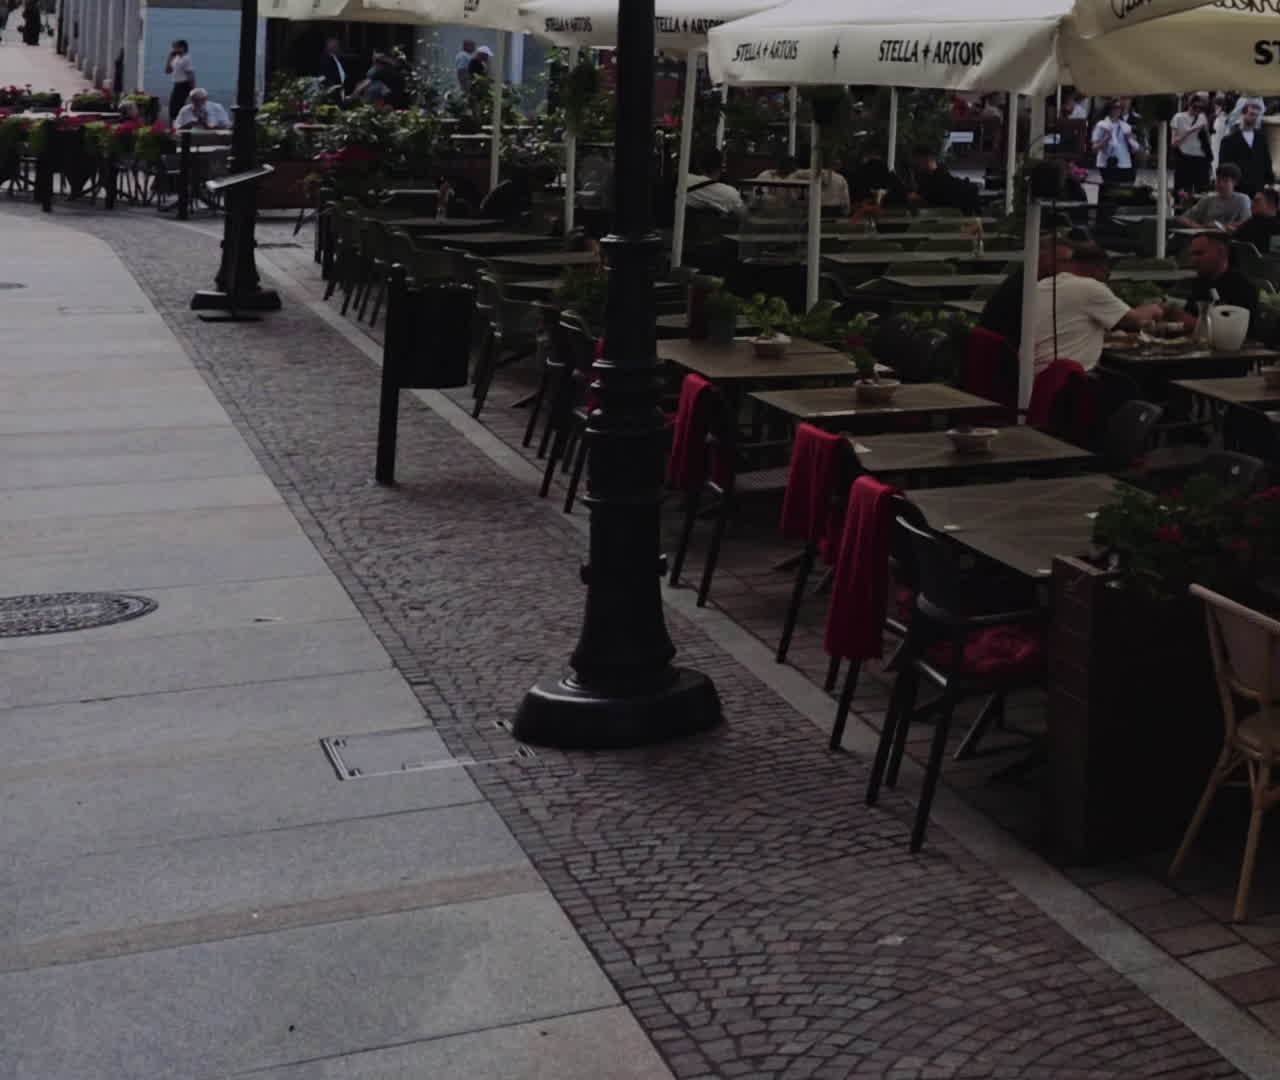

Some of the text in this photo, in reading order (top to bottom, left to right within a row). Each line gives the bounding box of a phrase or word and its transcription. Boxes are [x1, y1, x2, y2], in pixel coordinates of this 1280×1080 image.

[655, 16, 724, 34] TELLA ARTO
[732, 40, 800, 62] STELLA ARTOIS
[879, 39, 984, 66] STELLA ARTOIS
